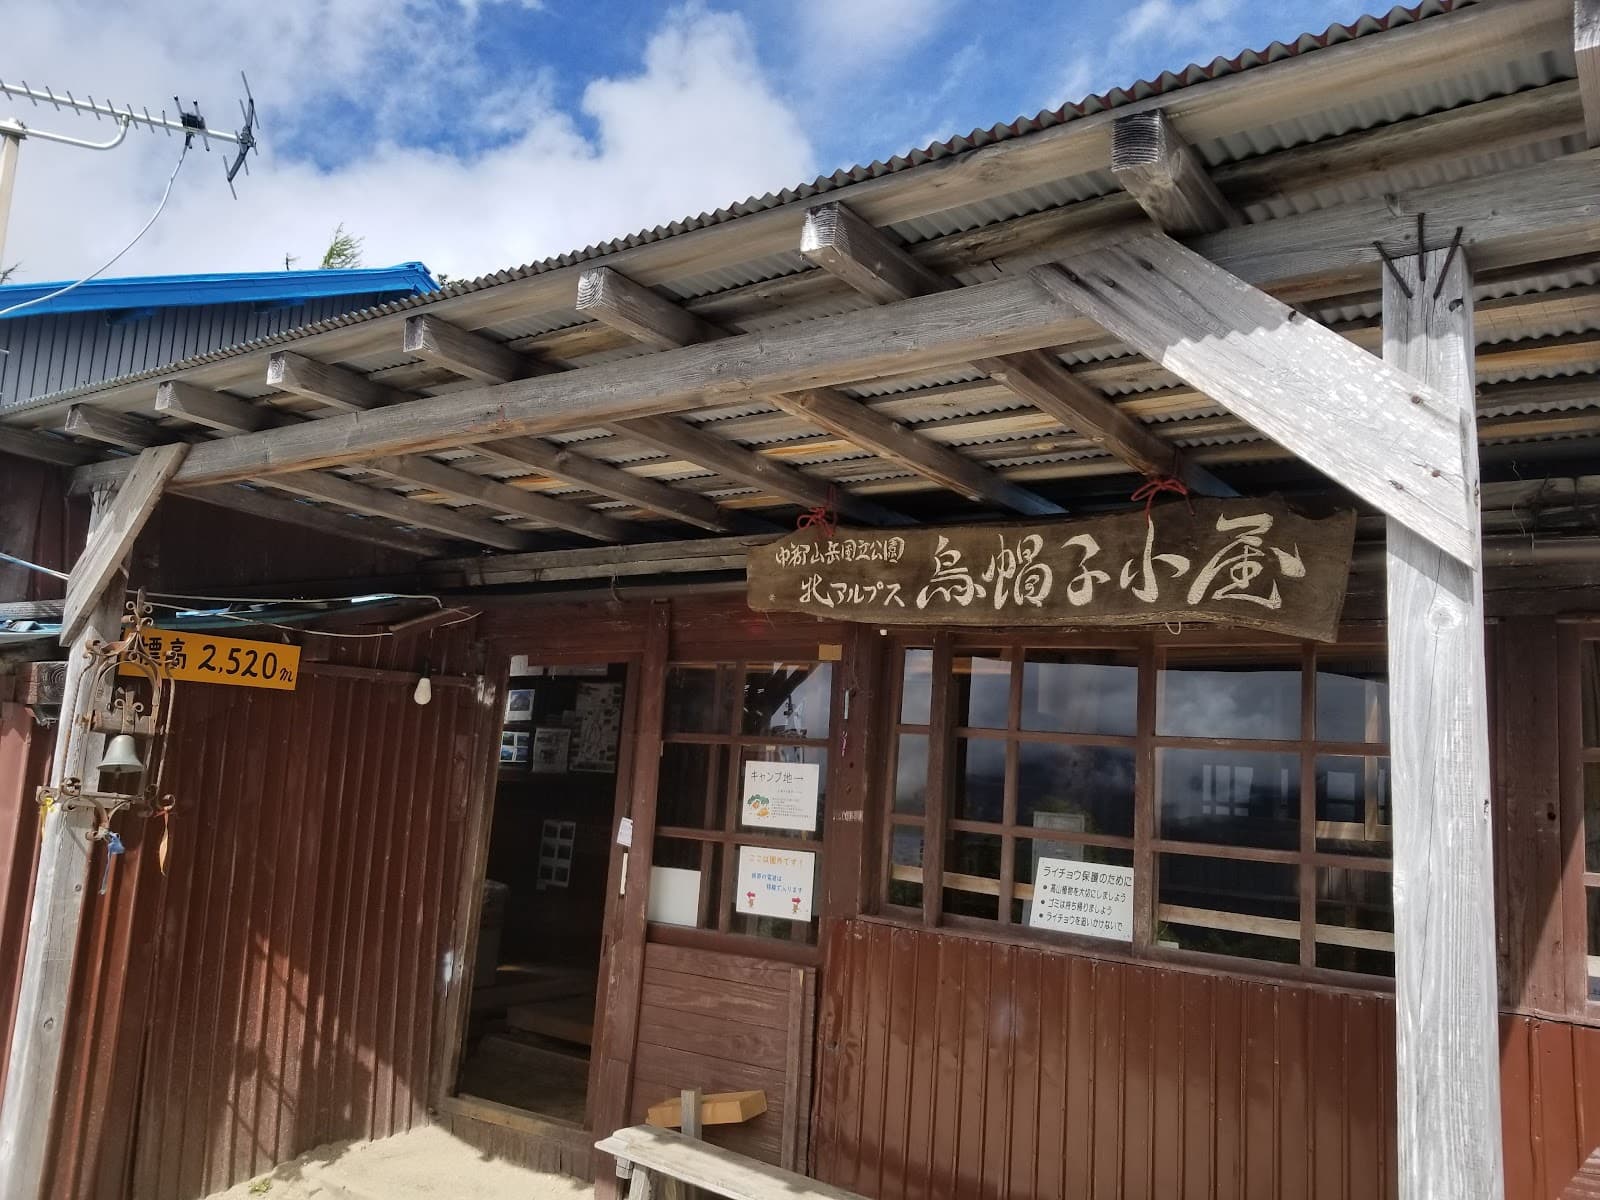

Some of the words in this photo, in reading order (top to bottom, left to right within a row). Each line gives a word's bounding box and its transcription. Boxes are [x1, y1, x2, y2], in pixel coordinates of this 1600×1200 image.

[799, 573, 905, 608] 北アルプス
[1043, 866, 1132, 887] ライチョウ保護のために
[1046, 912, 1123, 931] ライチョウを追いかけないで
